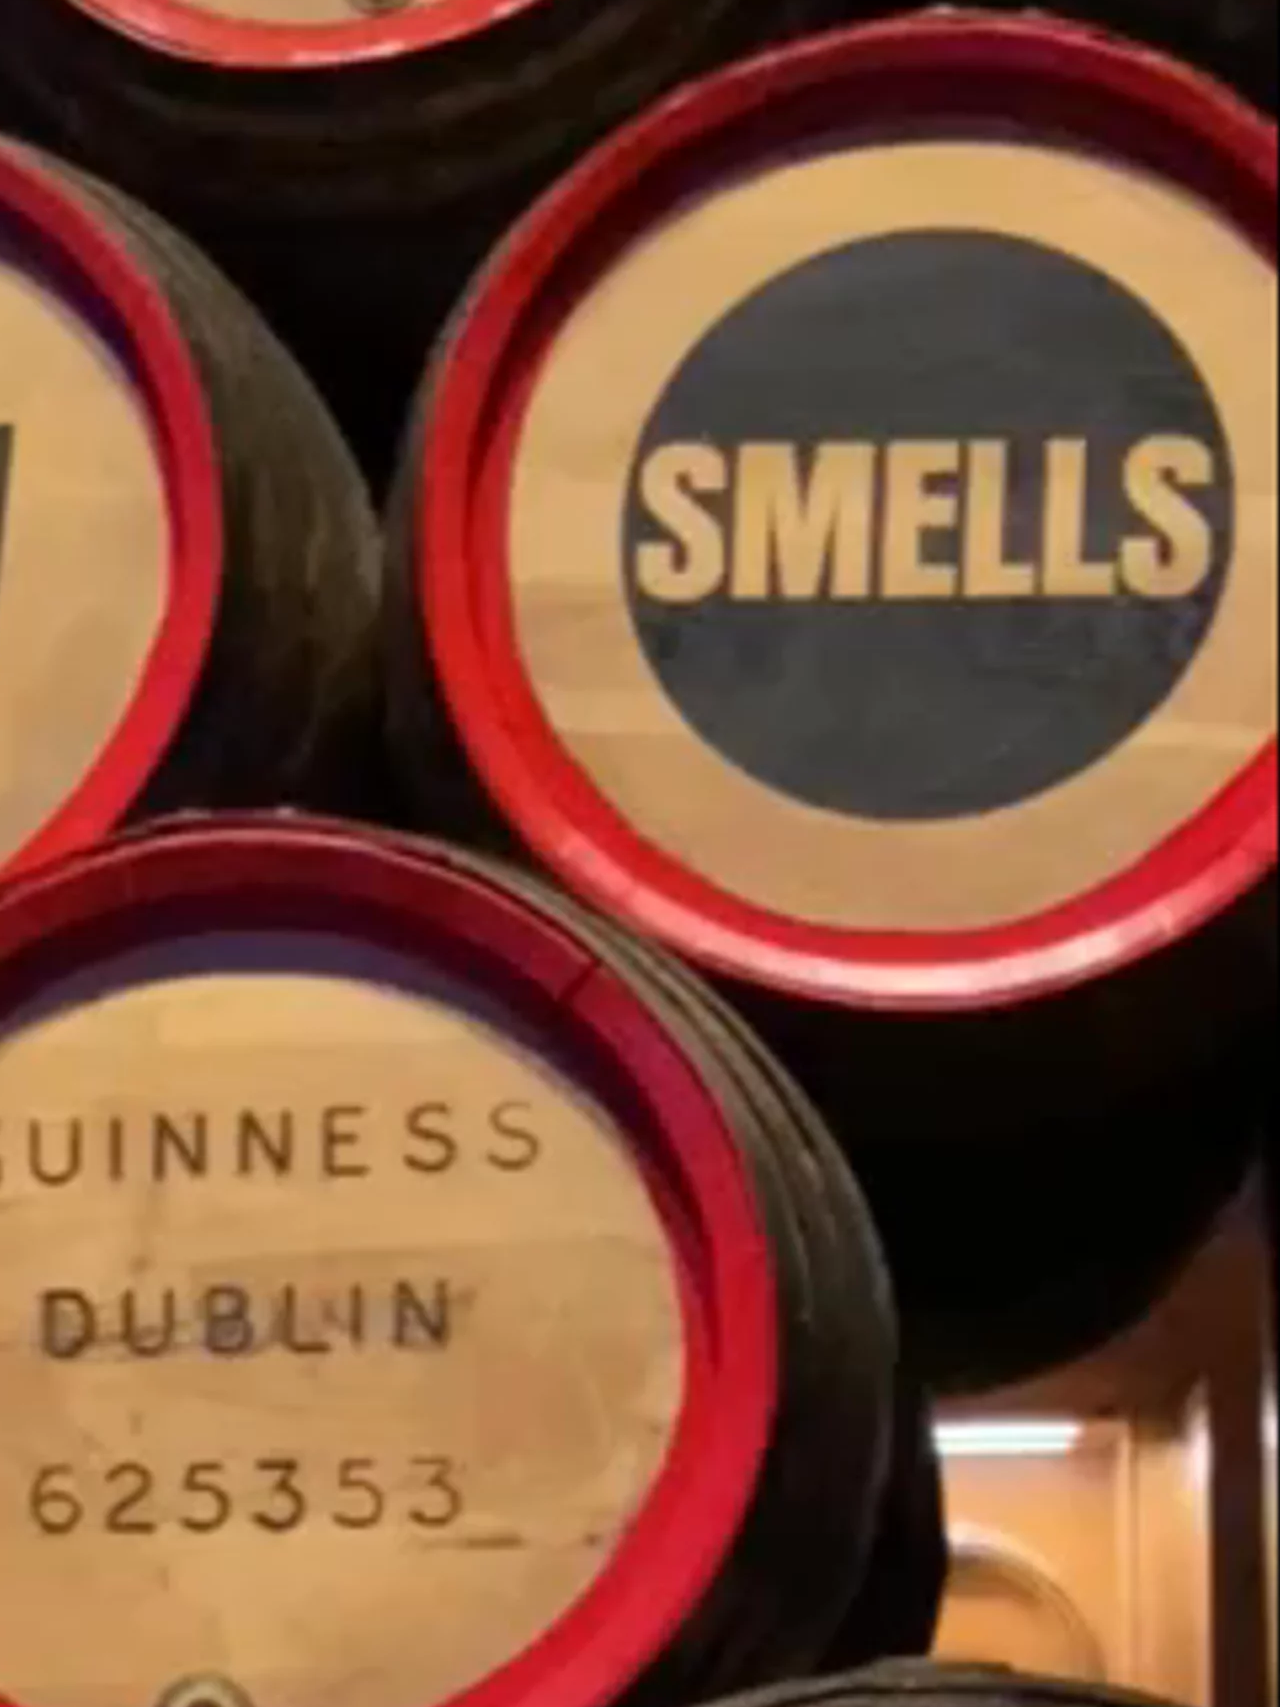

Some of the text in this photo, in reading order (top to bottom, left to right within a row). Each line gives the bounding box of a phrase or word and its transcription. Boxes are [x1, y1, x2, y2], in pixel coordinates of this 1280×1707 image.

[636, 433, 1214, 603] SMELLS
[40, 1277, 454, 1362] DUBLIN
[28, 1456, 467, 1537] 625353
